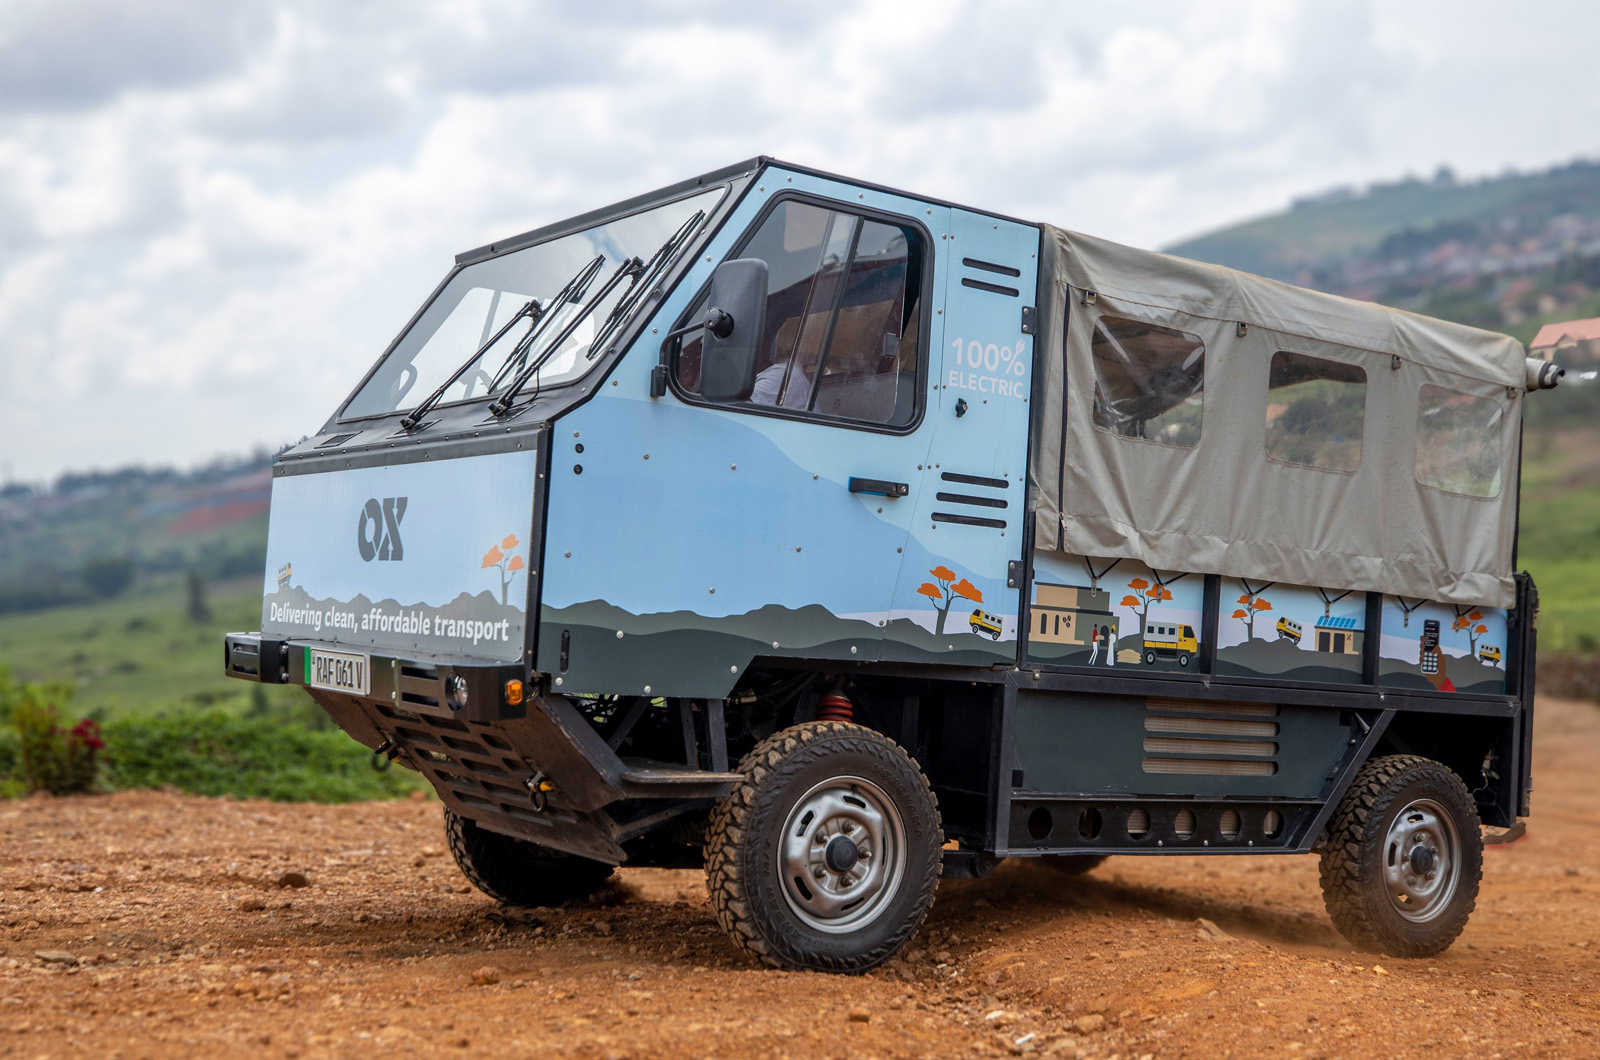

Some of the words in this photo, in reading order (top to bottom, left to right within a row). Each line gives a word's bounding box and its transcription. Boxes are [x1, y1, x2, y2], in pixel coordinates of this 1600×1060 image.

[951, 337, 1026, 377] 100%
[948, 370, 1024, 398] ELECTRIC
[358, 496, 408, 562] OX
[270, 602, 322, 632] Delivering
[324, 606, 358, 633] clean,
[361, 608, 431, 636] affordable
[434, 615, 509, 646] transport
